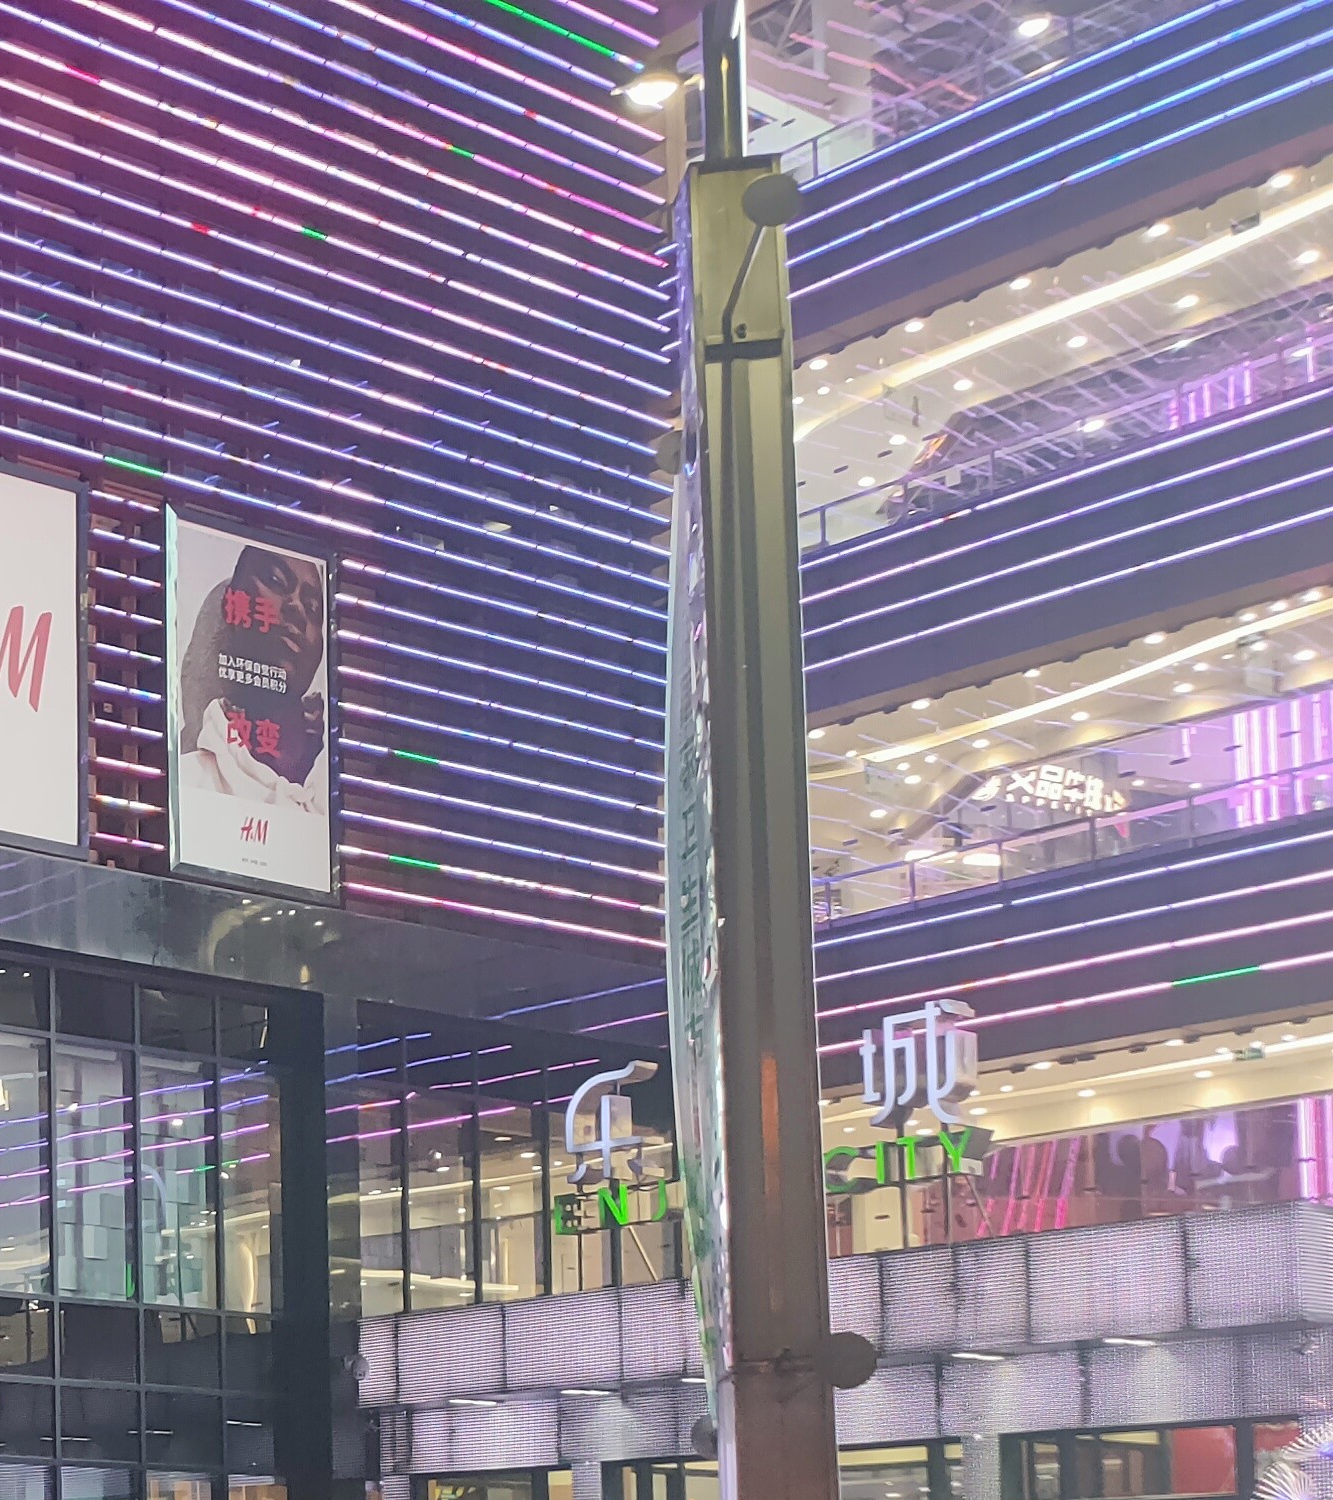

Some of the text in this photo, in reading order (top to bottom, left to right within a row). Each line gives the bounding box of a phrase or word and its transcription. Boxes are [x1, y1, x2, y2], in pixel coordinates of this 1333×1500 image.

[225, 586, 282, 633] 携手
[226, 710, 282, 758] 改变
[824, 1125, 981, 1192] CITY
